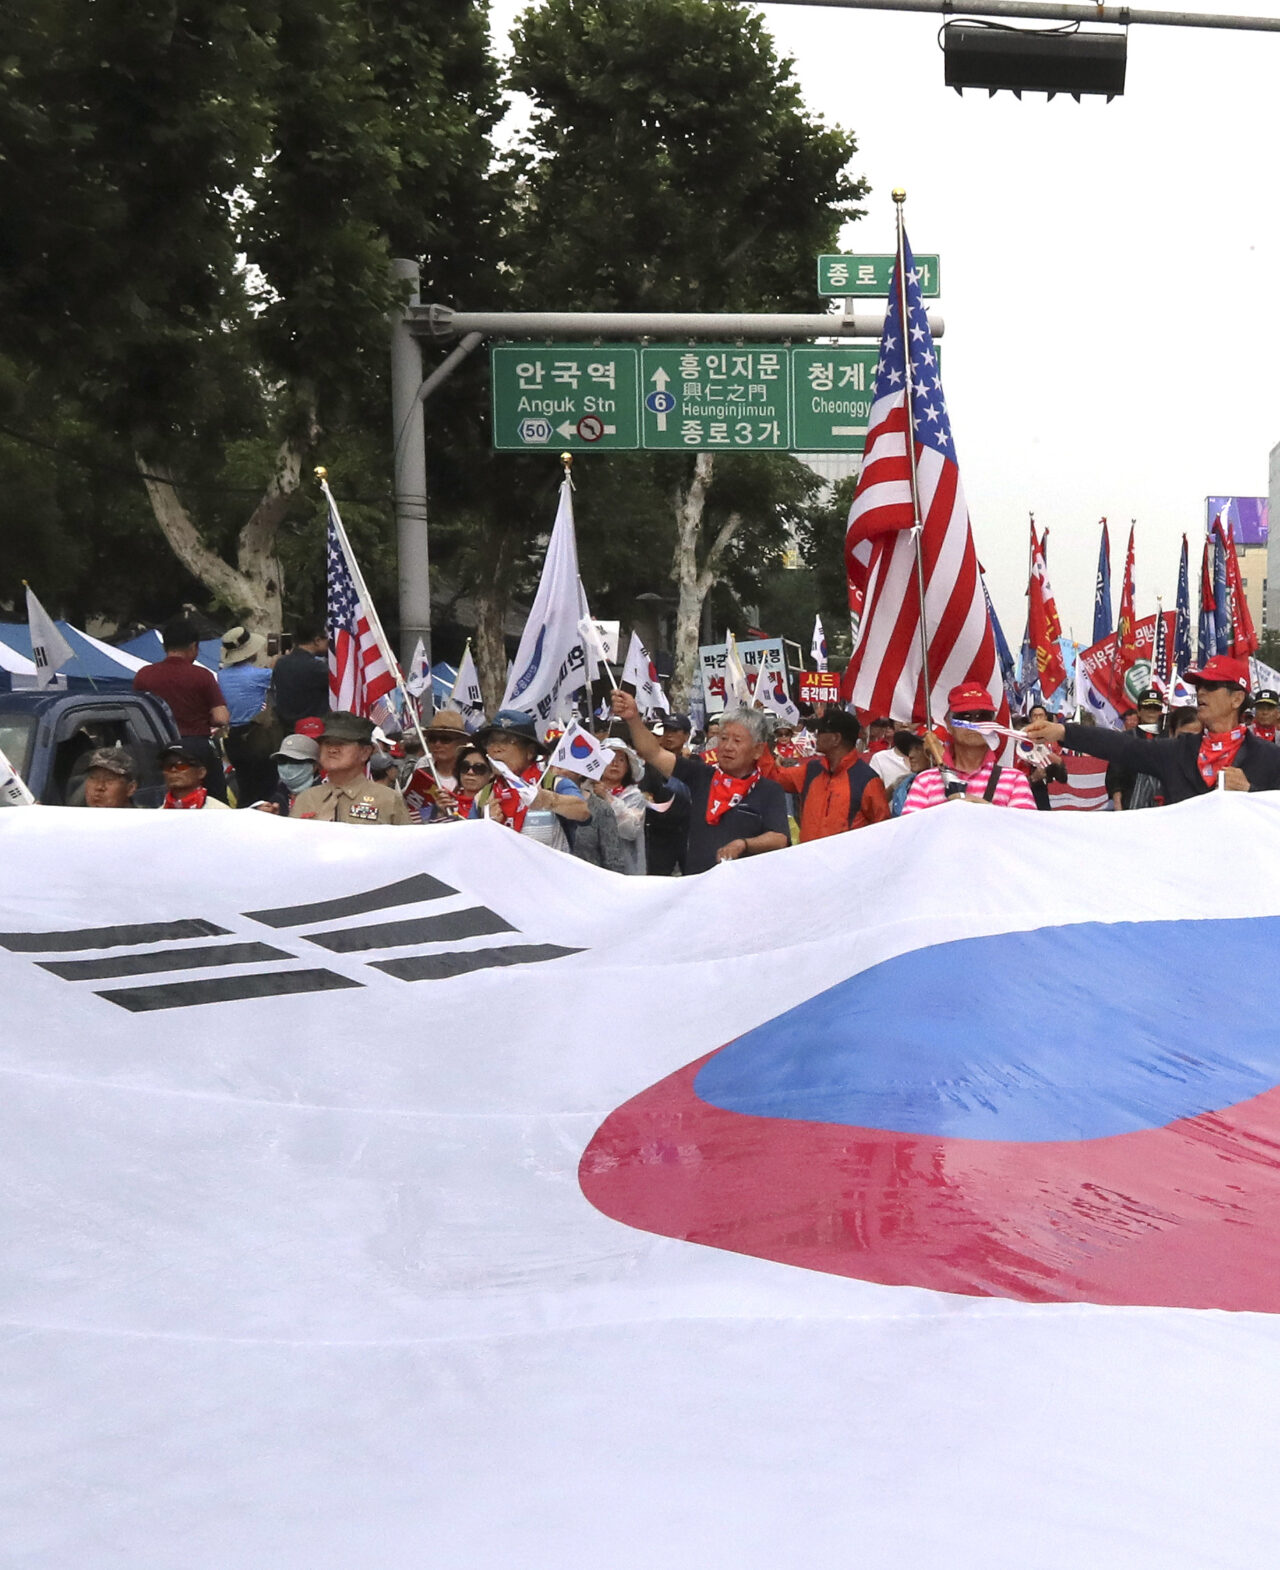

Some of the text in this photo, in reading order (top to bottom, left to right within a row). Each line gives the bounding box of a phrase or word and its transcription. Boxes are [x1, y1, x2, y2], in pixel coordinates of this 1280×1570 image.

[515, 361, 616, 390] 안국역
[678, 353, 781, 380] 흥인지문
[682, 382, 768, 402] 興仁之門
[517, 396, 616, 416] Anguk Stn
[654, 394, 667, 411] 6
[682, 402, 775, 419] Heunginjimun
[525, 424, 546, 437] 50
[680, 420, 781, 445] 종로3가
[703, 649, 728, 669] 박근
[806, 674, 834, 687] 사드
[801, 686, 837, 702] 즉각배치
